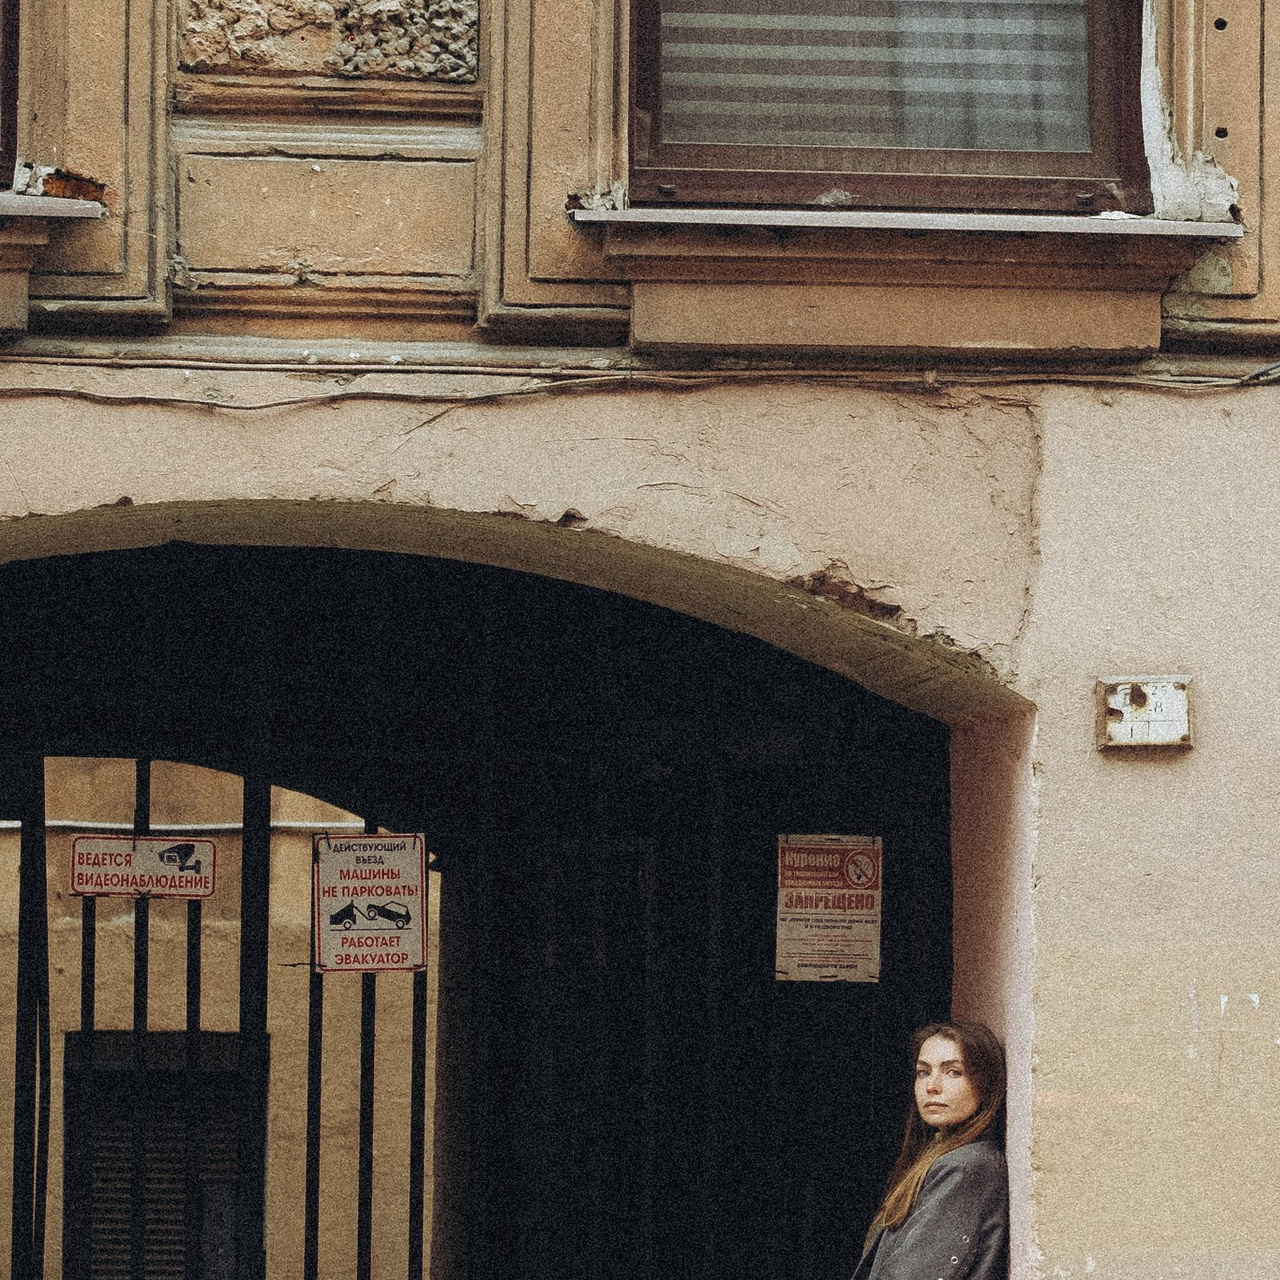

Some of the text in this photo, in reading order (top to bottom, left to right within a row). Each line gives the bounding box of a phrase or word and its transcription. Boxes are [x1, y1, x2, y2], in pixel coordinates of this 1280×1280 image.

[333, 841, 407, 853] ДЕЙСТВУЮЩИЙ
[77, 852, 133, 867] ВЕДЕТСЯ
[355, 855, 385, 865] ВЪЕЗД
[339, 868, 401, 880] МАШИНЫ
[77, 872, 210, 890] ВИДЕОНАБЛЮДЕНИЕ
[322, 885, 418, 898] НЕ ПАРКОВАТЬ!
[784, 892, 875, 912] ЗАПРЕЩЕНО
[341, 936, 402, 948] РАБОТАЕТ
[335, 953, 409, 965] ЭВАКУАТОР
